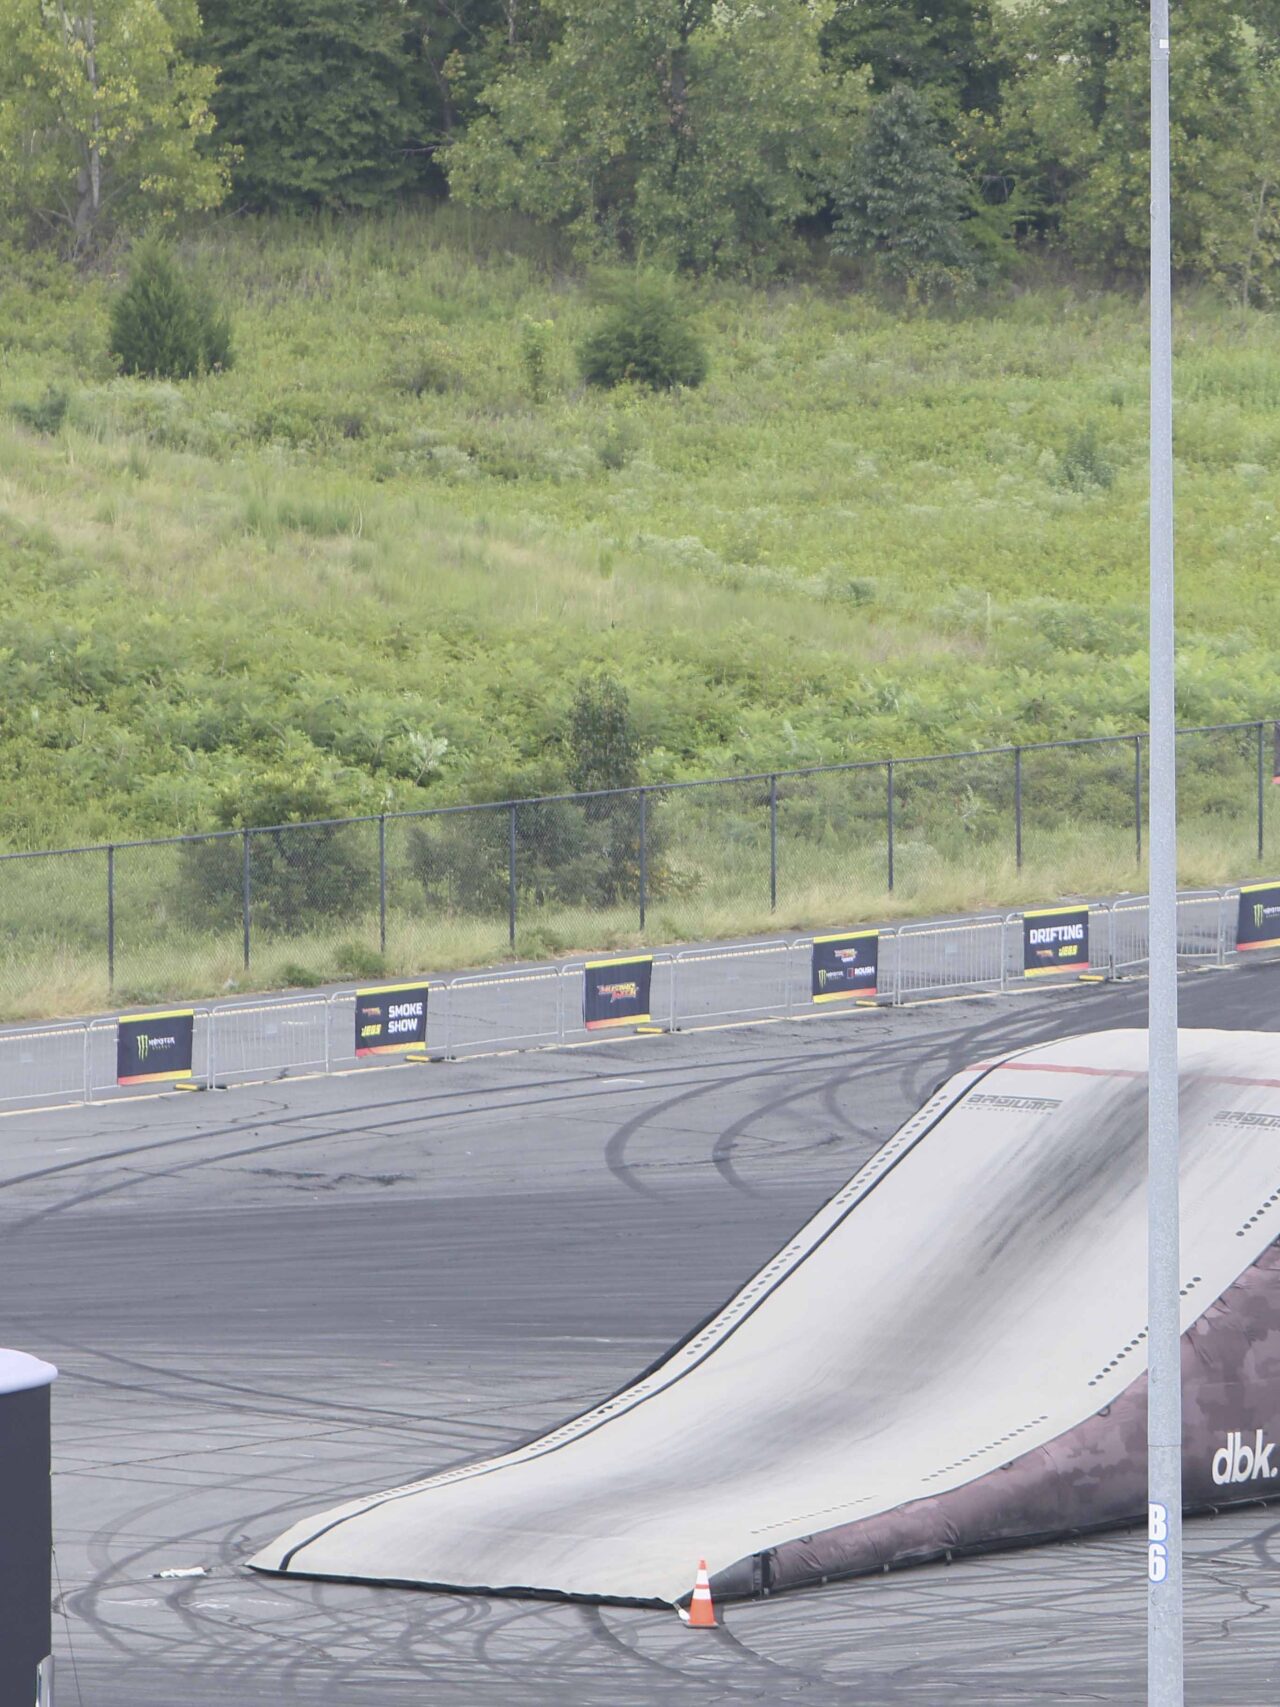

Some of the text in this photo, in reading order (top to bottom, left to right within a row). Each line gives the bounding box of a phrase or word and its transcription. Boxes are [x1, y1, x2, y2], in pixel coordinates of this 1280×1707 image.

[1029, 924, 1084, 944] DRIFTING
[388, 1002, 423, 1018] SMOKE
[387, 1018, 418, 1034] SHOW
